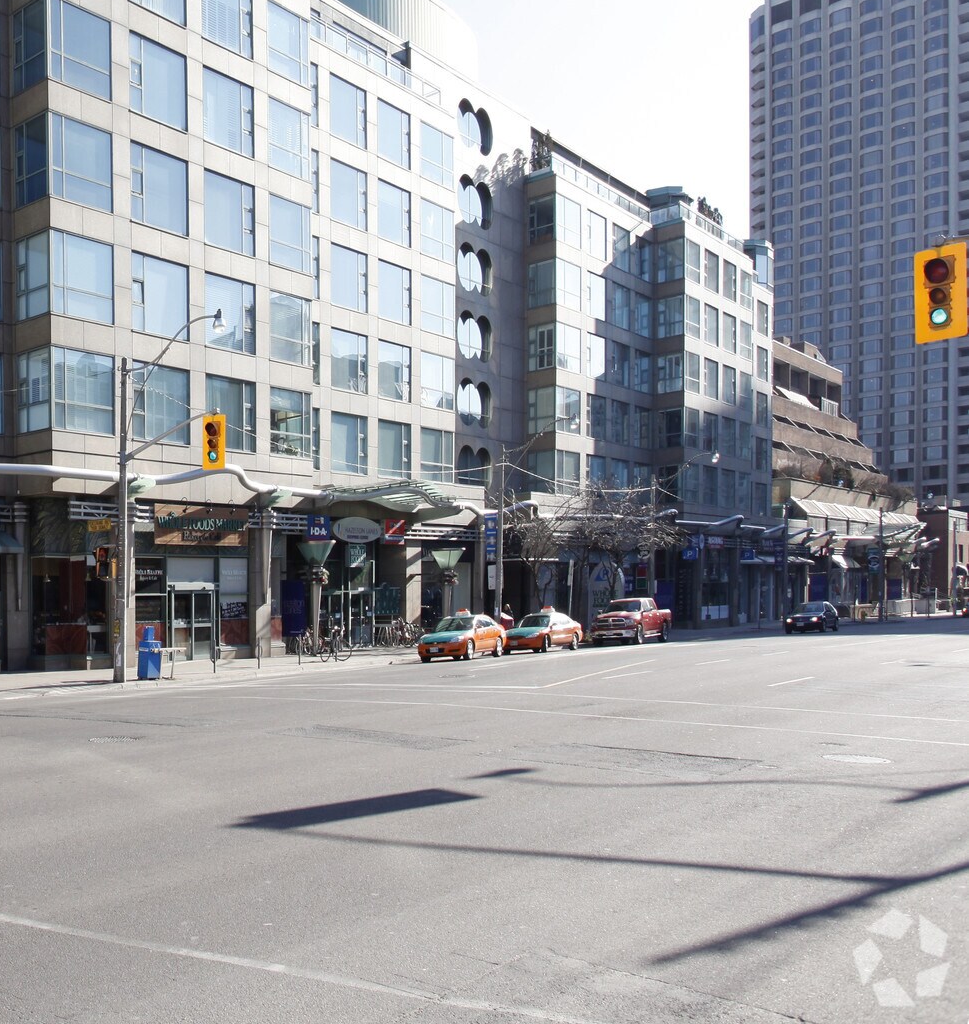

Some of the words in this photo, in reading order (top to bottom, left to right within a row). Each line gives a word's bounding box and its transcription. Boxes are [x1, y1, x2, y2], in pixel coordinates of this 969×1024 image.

[157, 512, 188, 529] WHOLE
[188, 517, 215, 531] FOODS
[215, 518, 249, 531] MARKET
[344, 527, 366, 535] HAZELTON
